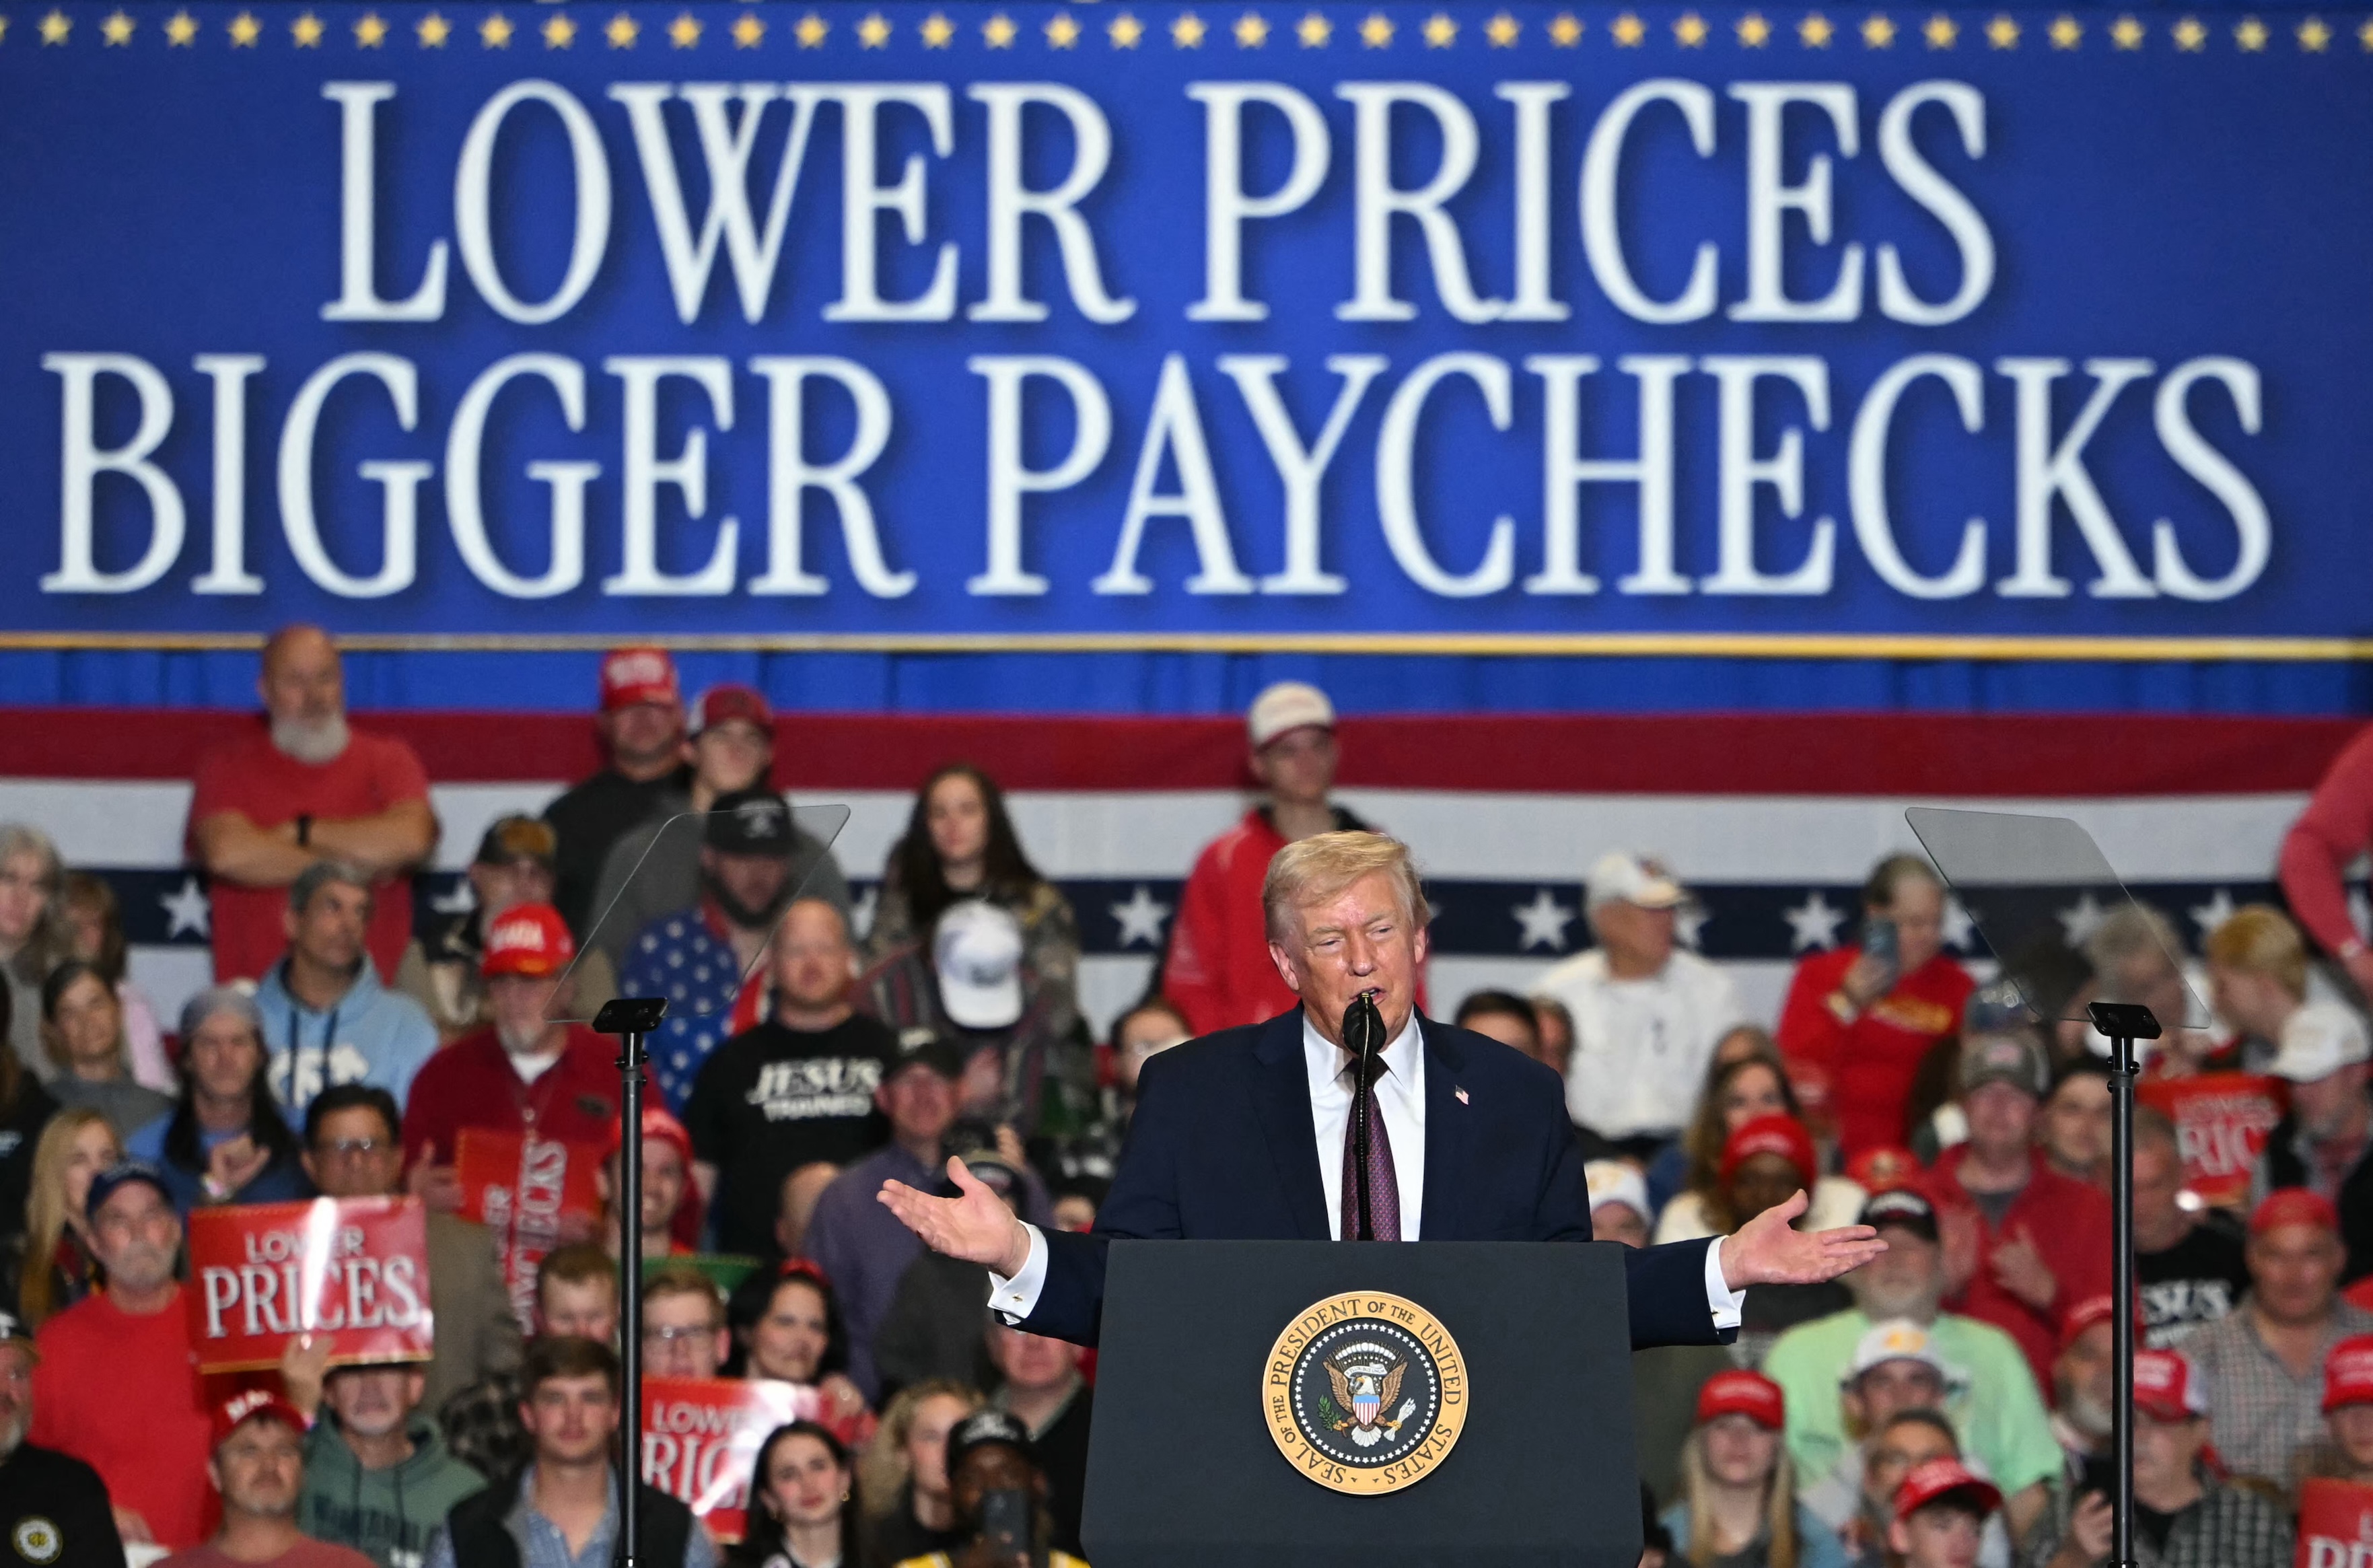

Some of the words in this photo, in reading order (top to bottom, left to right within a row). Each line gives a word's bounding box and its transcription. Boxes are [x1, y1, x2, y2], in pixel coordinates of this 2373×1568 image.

[320, 79, 1137, 324] LOWER
[1186, 79, 1996, 326] PRICES
[40, 351, 918, 599] BIGGER
[966, 351, 2272, 601] PAYCHECKS
[745, 1055, 884, 1105] JESUS
[2176, 1118, 2269, 1175] RIC
[243, 1225, 365, 1265] LOWR
[201, 1254, 422, 1339] PRICES
[1367, 1301, 1386, 1313] OF
[1391, 1305, 1416, 1324] THE
[2141, 1279, 2232, 1323] SUS
[1270, 1299, 1361, 1388] PRESIDENT
[1420, 1322, 1462, 1405] UNITED
[650, 1398, 748, 1436] LOWE
[1273, 1394, 1288, 1423] THE
[1280, 1427, 1296, 1444] OF
[1383, 1423, 1453, 1485] STATES
[641, 1431, 752, 1510] RIC
[1296, 1442, 1347, 1484] SEAL
